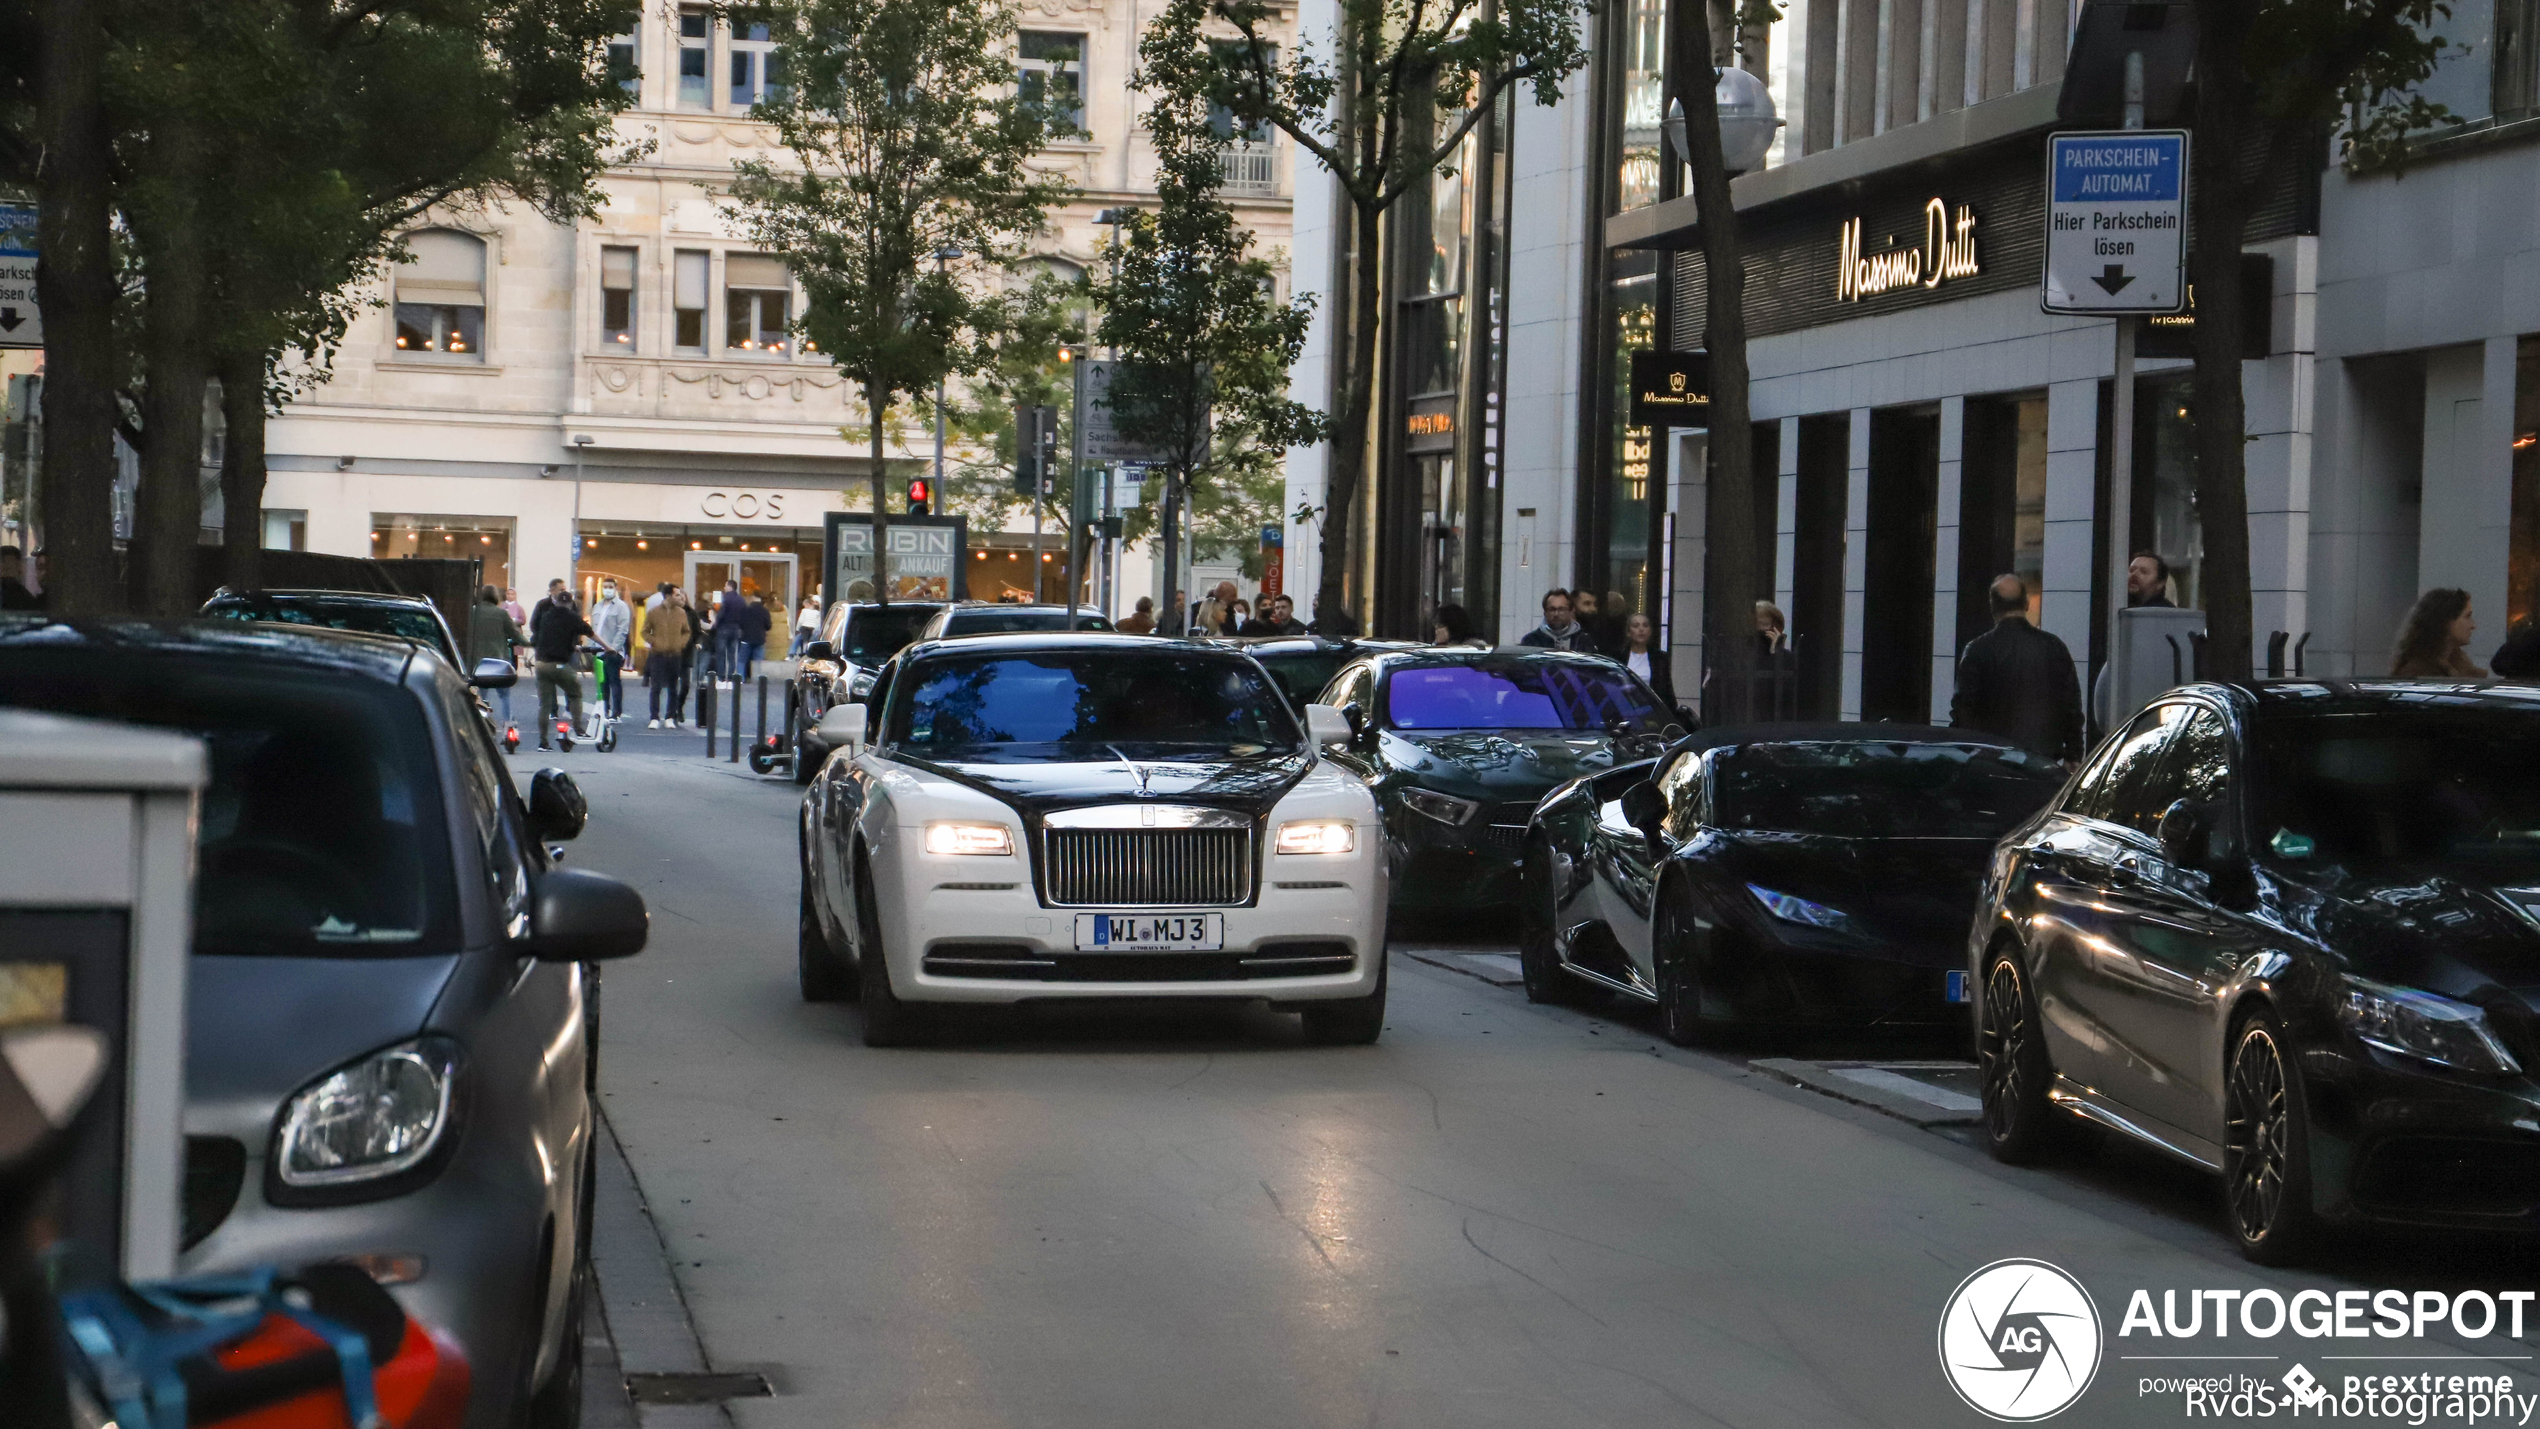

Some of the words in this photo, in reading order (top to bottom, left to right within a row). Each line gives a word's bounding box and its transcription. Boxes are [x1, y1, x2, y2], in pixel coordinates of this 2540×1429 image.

[2065, 148, 2170, 168] PARKSCHEIN-
[2081, 174, 2152, 193] AUTOMAT
[2054, 212, 2085, 231] Hier
[2093, 211, 2176, 230] Parkschein
[1838, 217, 1921, 301] Massimo
[1925, 197, 1979, 288] Dutti
[2095, 237, 2134, 256] lösen
[1644, 392, 1684, 403] Massimo
[1687, 392, 1709, 404] Dutti
[701, 492, 784, 520] COS
[899, 557, 948, 573] ANKAUF
[1109, 919, 1138, 942] WI
